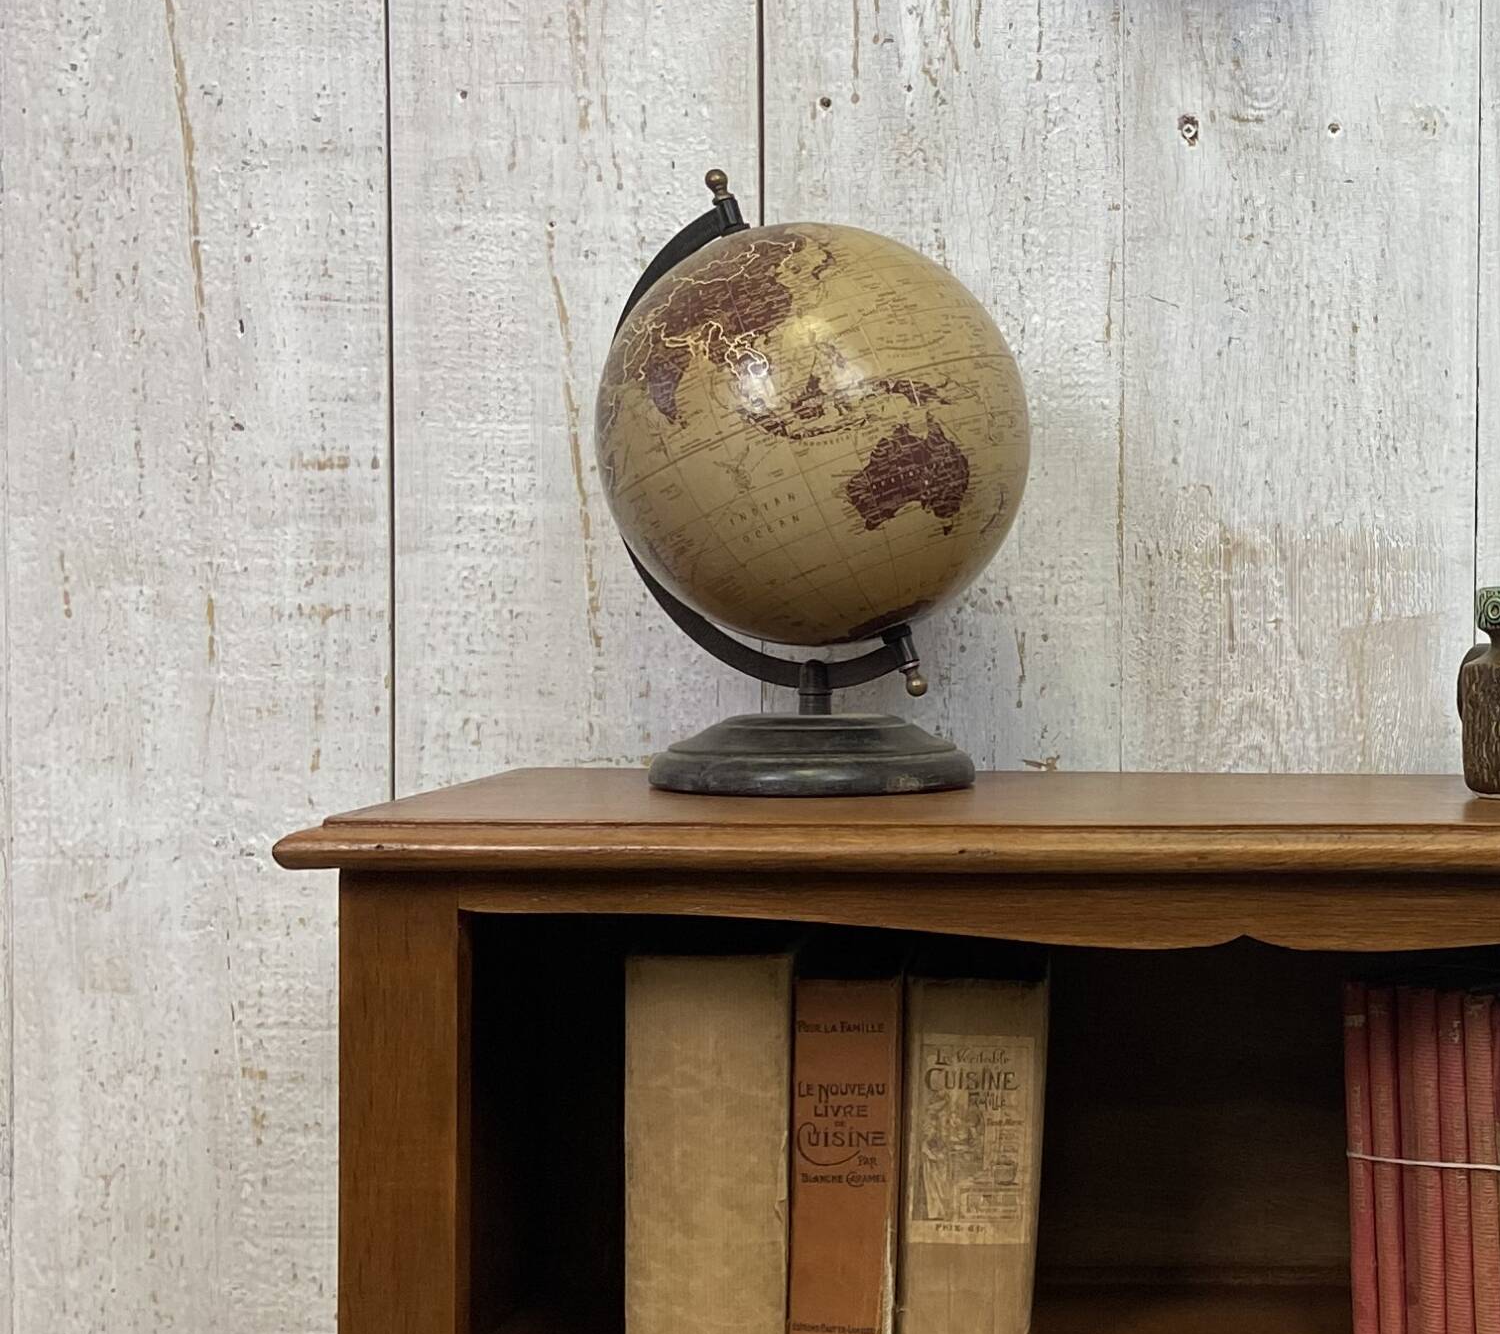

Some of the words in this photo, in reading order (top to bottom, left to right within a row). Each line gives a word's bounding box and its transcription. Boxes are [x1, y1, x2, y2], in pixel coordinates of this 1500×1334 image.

[742, 514, 801, 544] OCEAN
[924, 1067, 1021, 1091] CUISINE
[797, 1080, 815, 1098] LE
[817, 1082, 886, 1104] NOUVEAU
[813, 1099, 869, 1118] LIVRE
[796, 1121, 887, 1167] CUISINE
[857, 1154, 879, 1168] PAR
